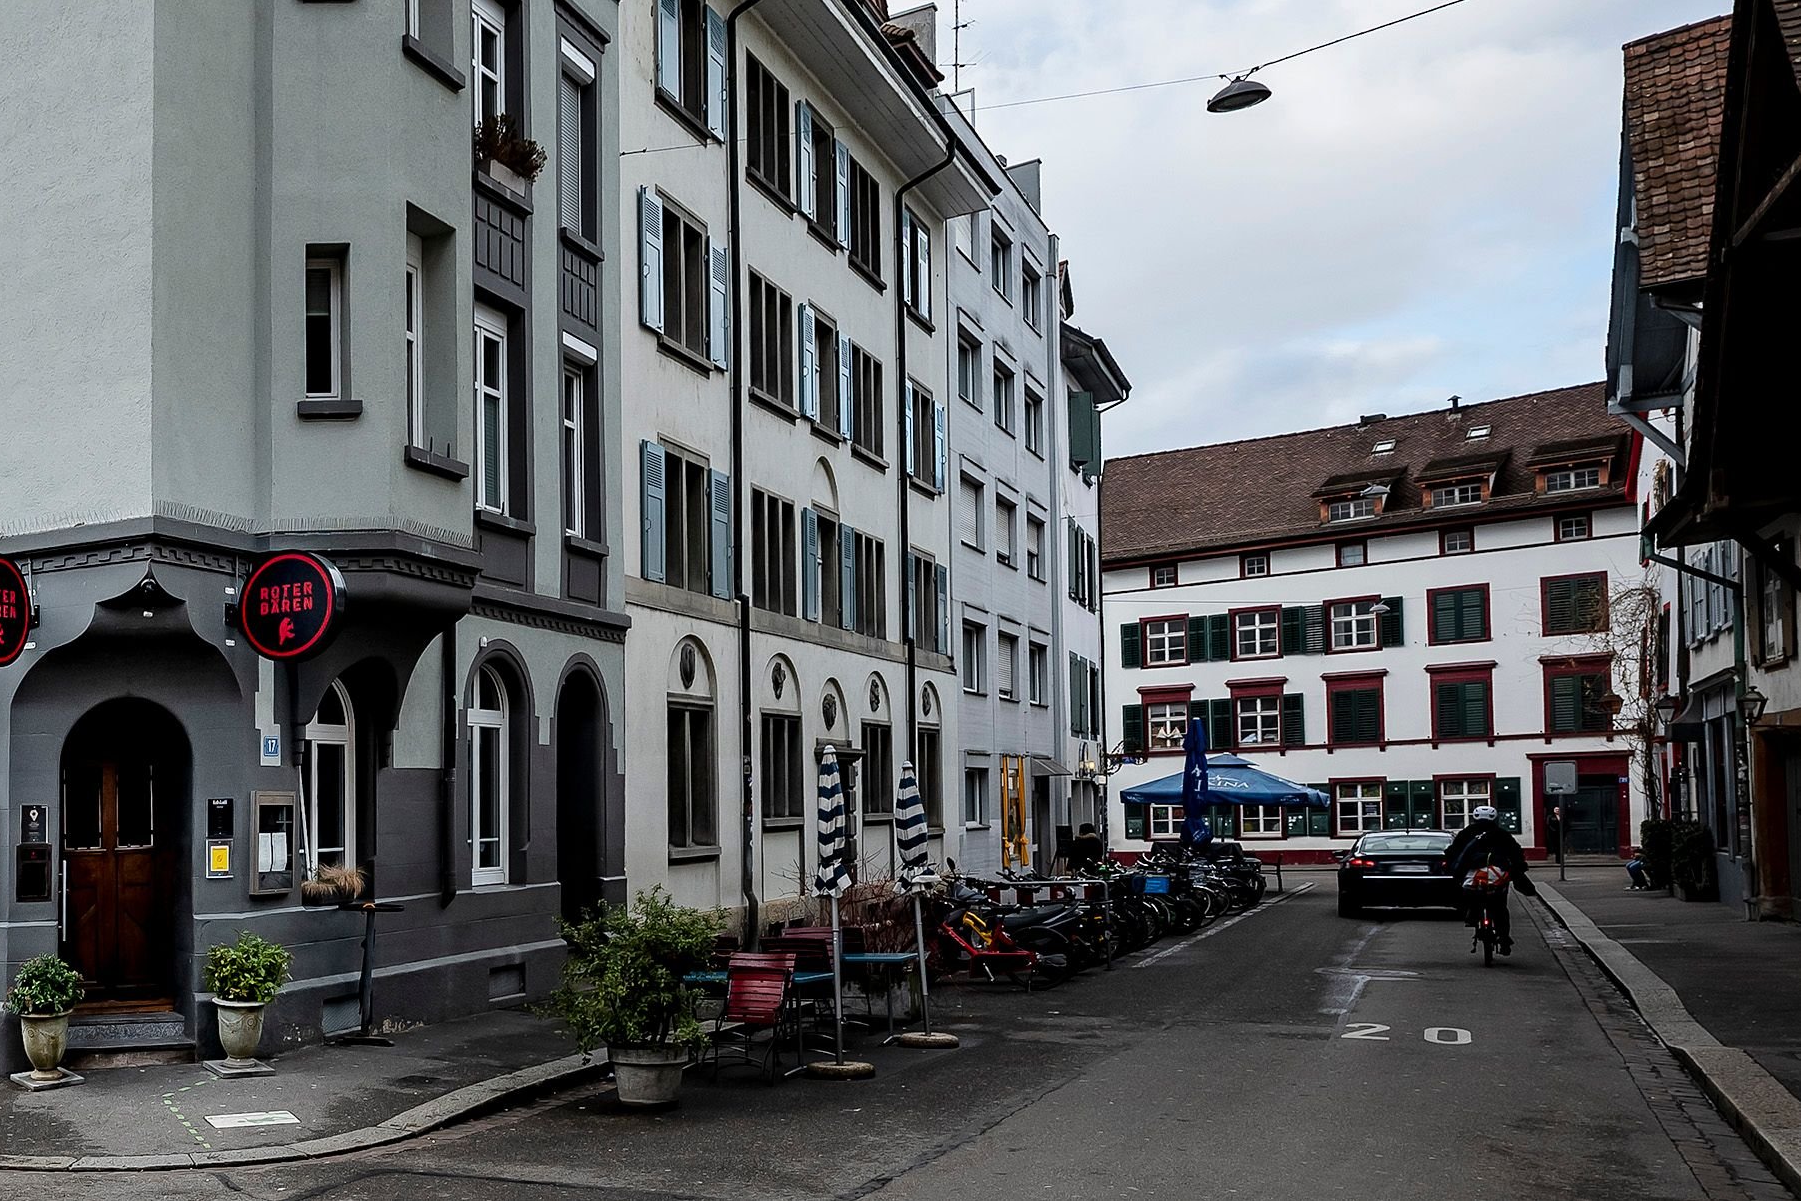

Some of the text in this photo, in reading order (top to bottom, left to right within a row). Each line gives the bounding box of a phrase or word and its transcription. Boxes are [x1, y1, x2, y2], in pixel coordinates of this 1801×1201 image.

[260, 581, 313, 600] ROTER
[260, 596, 313, 616] BÄREN
[268, 739, 276, 753] 17
